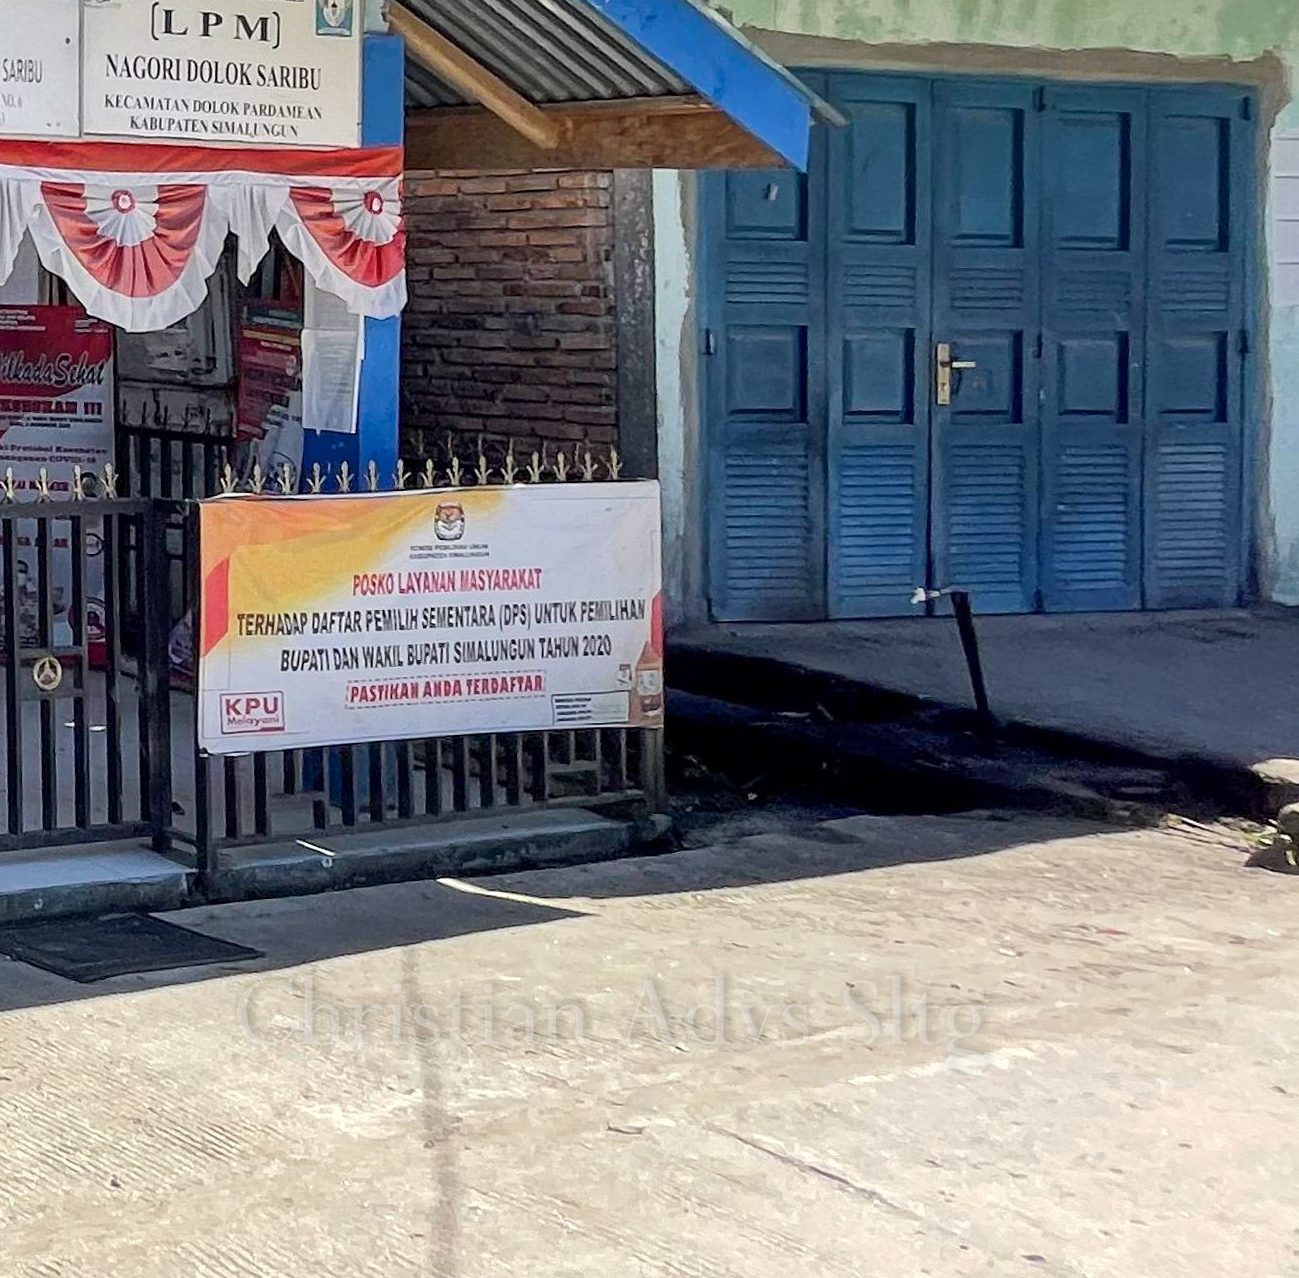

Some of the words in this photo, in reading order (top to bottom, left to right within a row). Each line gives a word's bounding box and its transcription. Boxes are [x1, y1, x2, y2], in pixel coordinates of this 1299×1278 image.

[2, 58, 43, 83] SARIBU
[106, 54, 181, 81] NAGORI
[186, 59, 252, 86] DOLOK
[256, 64, 321, 91] SARIBU
[104, 94, 190, 113] KECAMATAN
[193, 99, 240, 116] DOLOK
[243, 103, 323, 120] PARDAMEAN
[130, 116, 209, 134] KABUPATEN
[211, 120, 299, 138] SIMALUNGUN
[352, 573, 394, 596] POSKO
[399, 570, 456, 595] LAYANAN
[460, 567, 543, 592] MASYARAKAT
[237, 612, 308, 636] TERHADAP
[312, 610, 362, 635] DAFTAR
[365, 606, 419, 633] PEMILIH
[421, 603, 496, 630] SEMENTARA
[499, 602, 532, 632] (DPS)
[534, 600, 577, 625] UNTUK
[580, 598, 646, 623] PEMILIHAN
[280, 649, 330, 672] BUPATI
[333, 647, 359, 670] DAN
[362, 644, 404, 669] WAKIL
[407, 641, 450, 667] BUPATI
[453, 637, 536, 664] SIMALUNGUN
[538, 635, 579, 660] TAHUN
[582, 633, 612, 657] 2020
[350, 682, 419, 704] PASTIKAN
[422, 679, 463, 699] ANDA
[466, 674, 543, 696] TERDAFTAR
[225, 696, 279, 716] KPU
